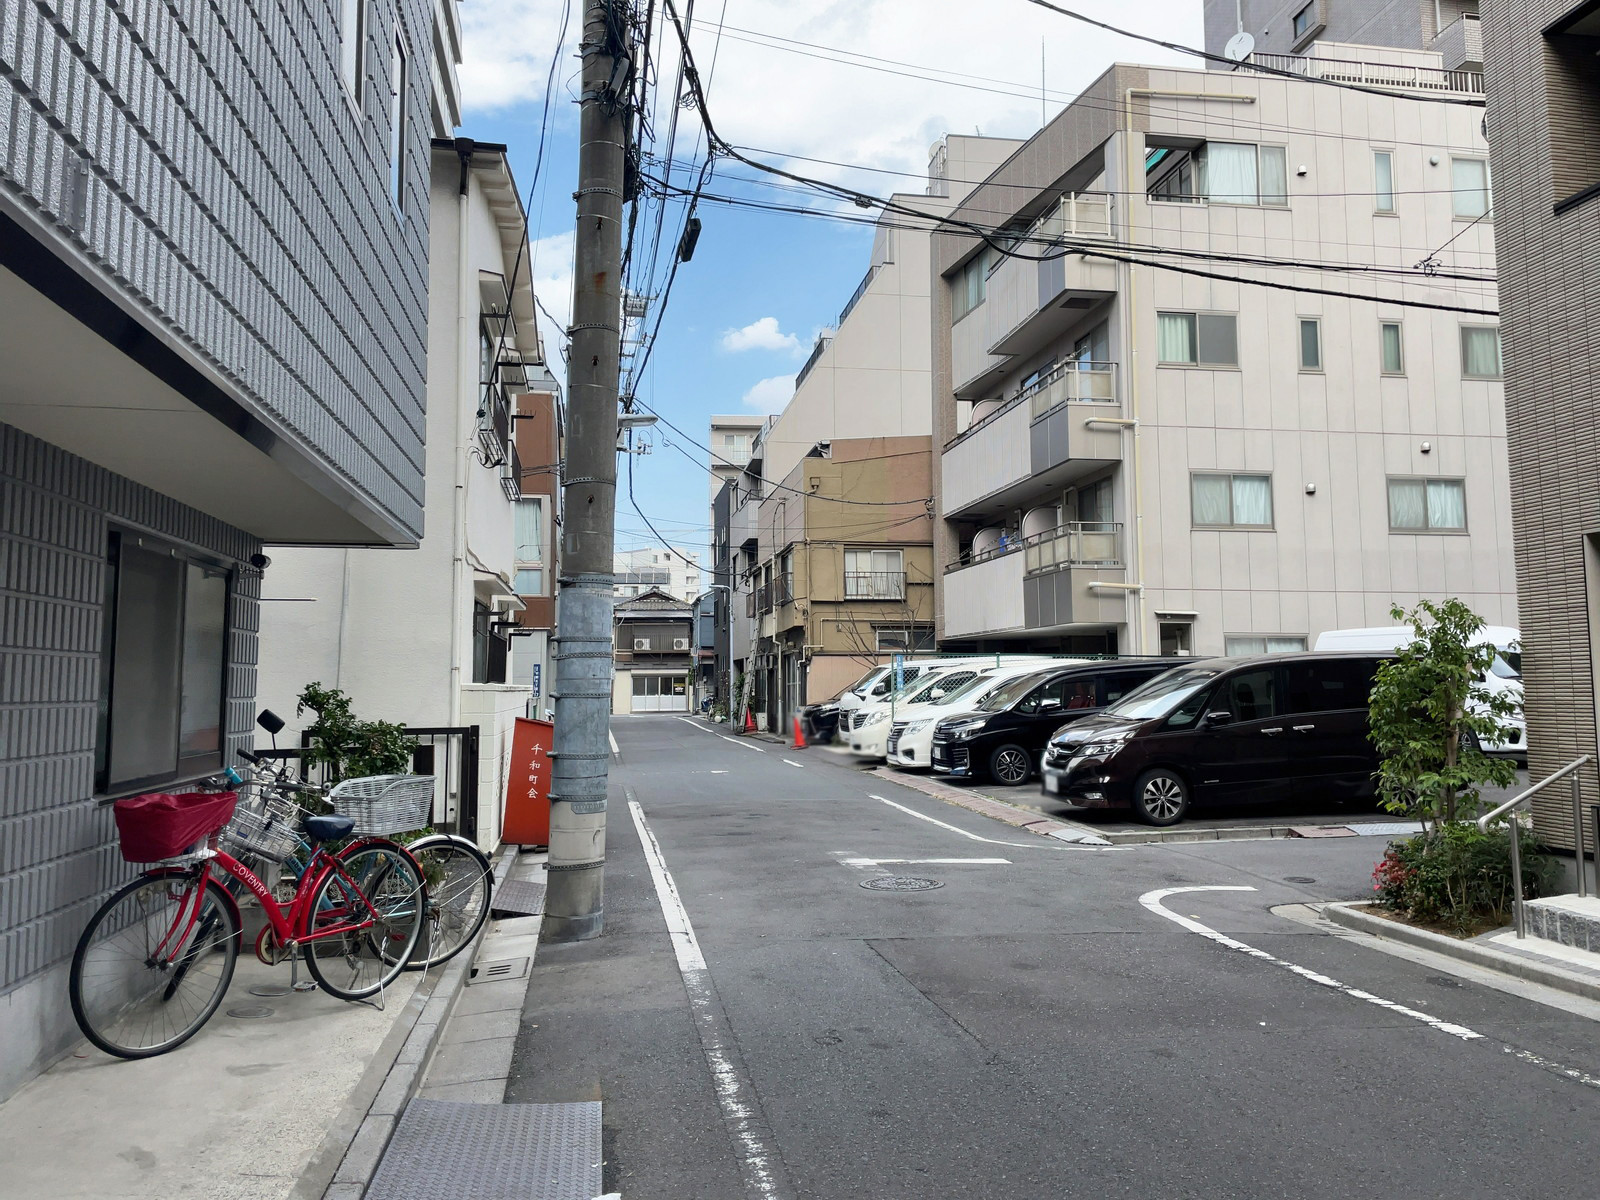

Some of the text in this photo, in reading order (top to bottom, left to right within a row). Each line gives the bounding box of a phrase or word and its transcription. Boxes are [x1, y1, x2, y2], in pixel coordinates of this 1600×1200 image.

[527, 743, 543, 799] 千和町会
[232, 862, 268, 897] COVENTRY
